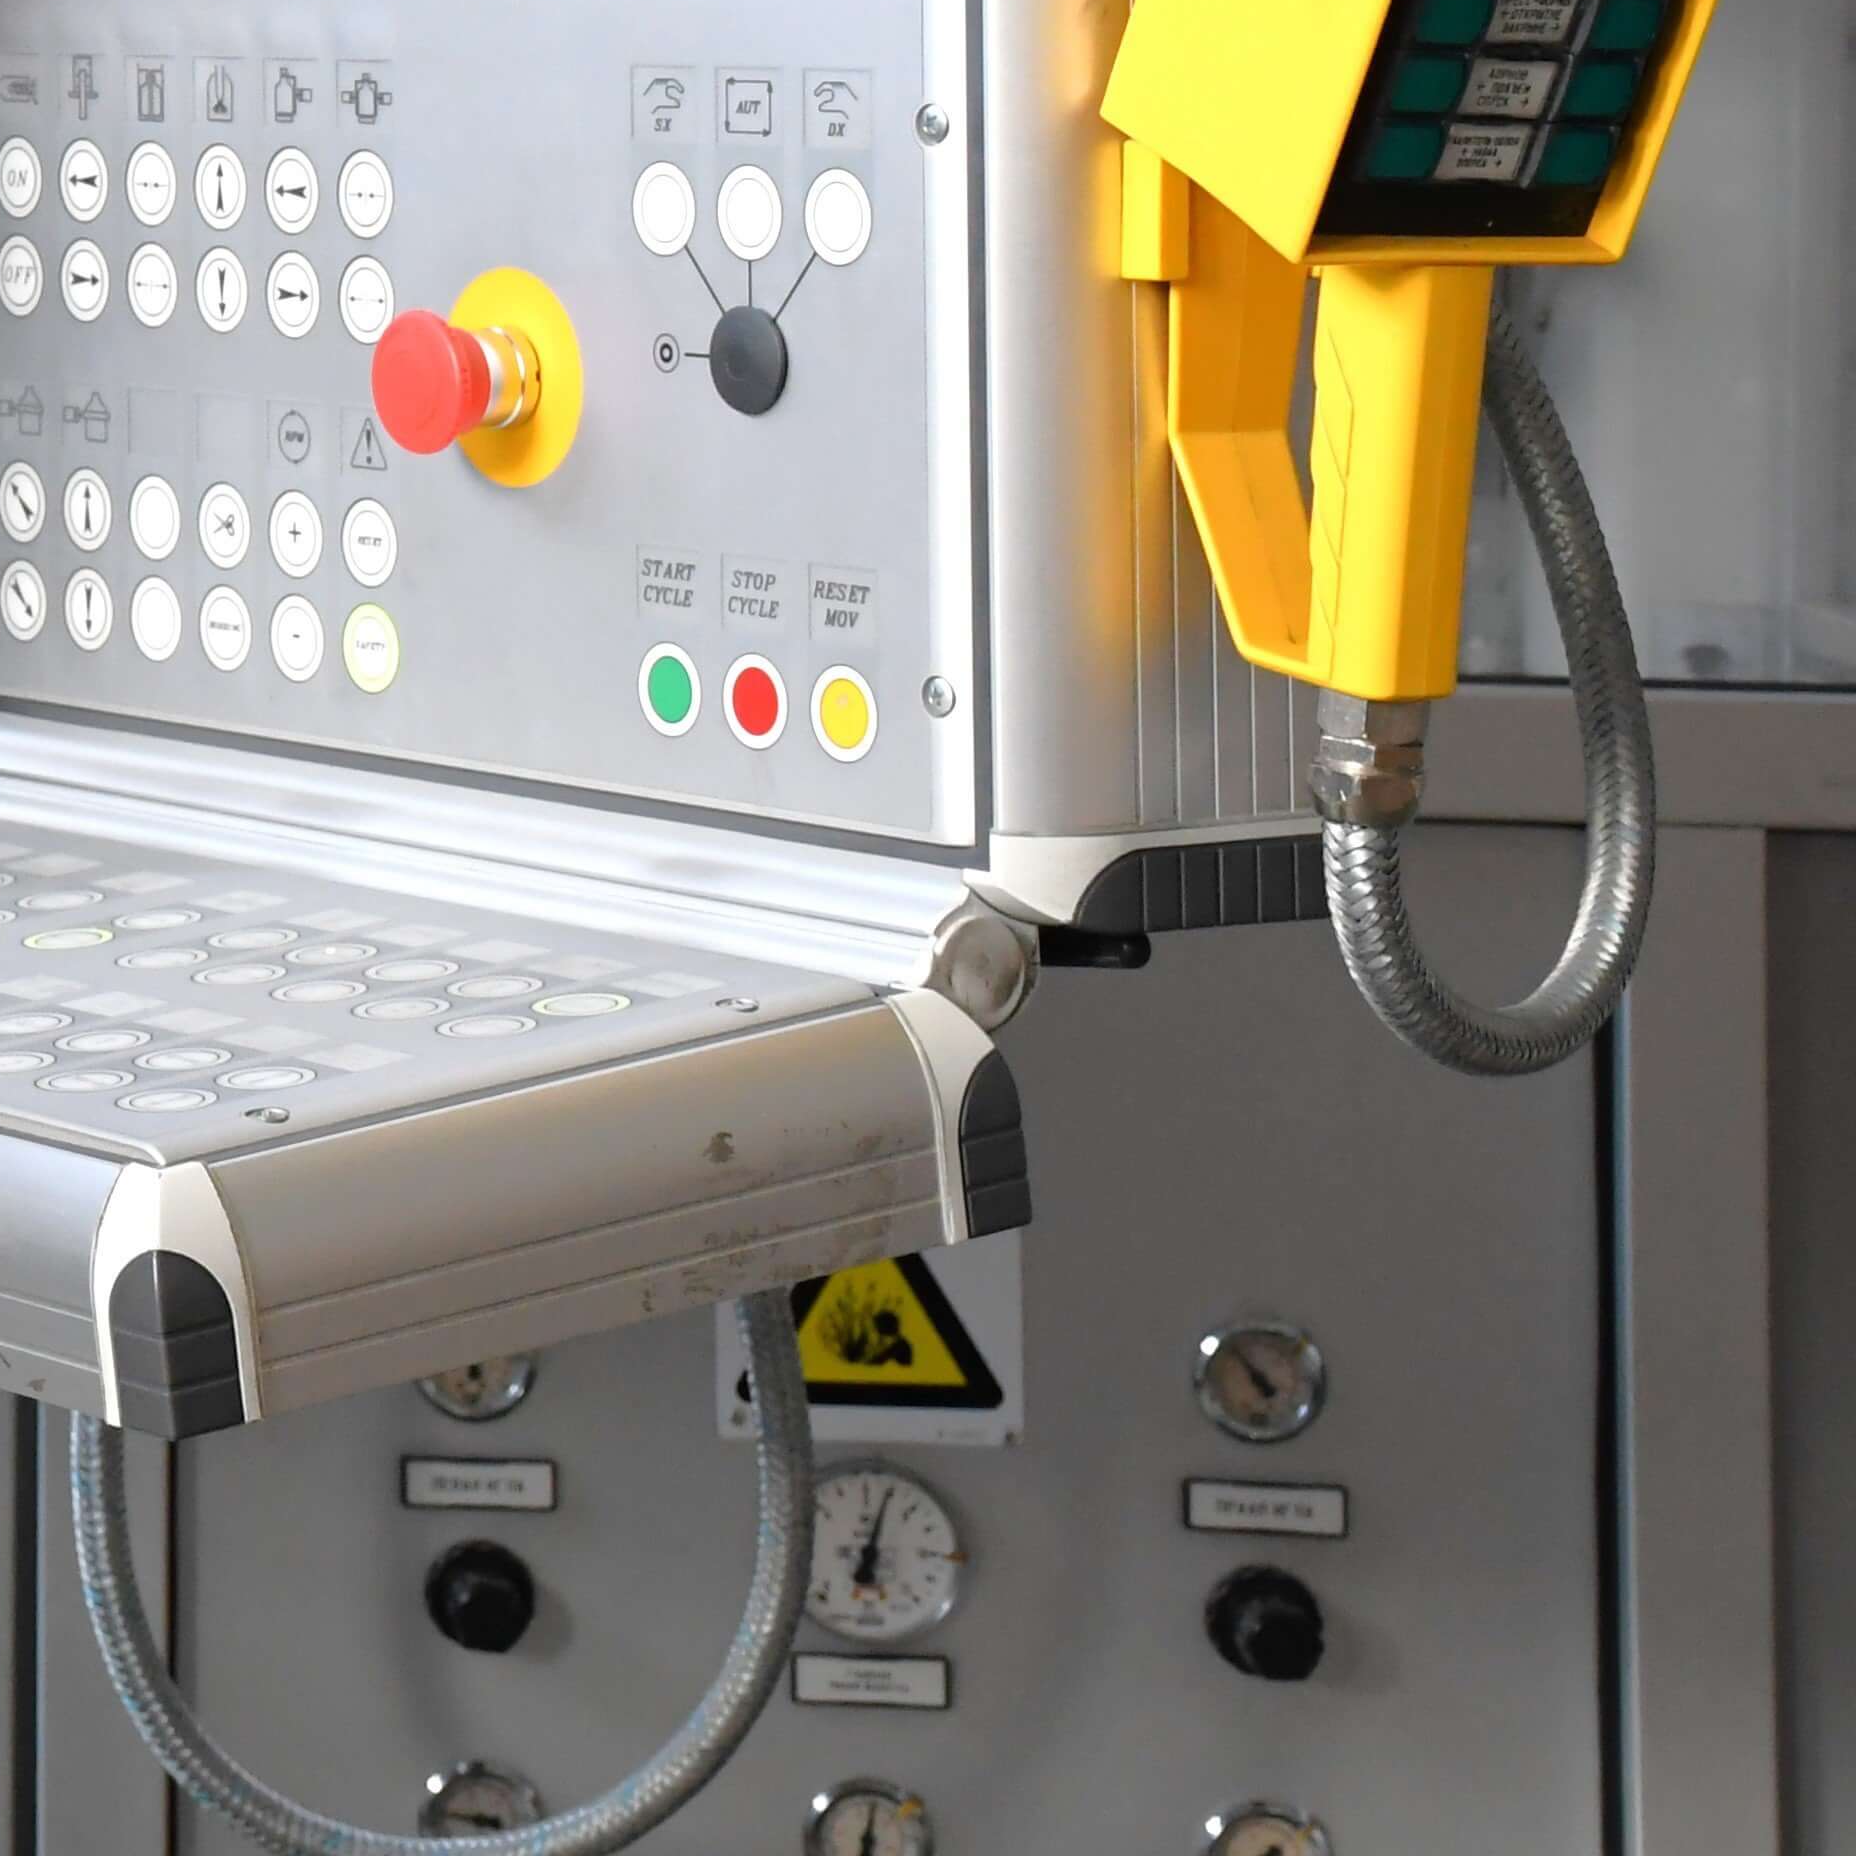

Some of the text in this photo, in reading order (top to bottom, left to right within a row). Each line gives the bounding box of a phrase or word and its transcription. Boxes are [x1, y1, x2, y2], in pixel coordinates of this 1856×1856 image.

[736, 100, 761, 115] AUT
[654, 118, 672, 132] SX
[827, 122, 846, 137] DX
[7, 169, 28, 187] ON
[5, 265, 34, 285] OFF
[641, 558, 696, 581] START
[731, 570, 776, 592] STOP
[643, 585, 694, 608] CYCLE
[813, 580, 870, 604] RESET
[728, 596, 780, 619] CYCLE
[824, 608, 859, 628] MOV
